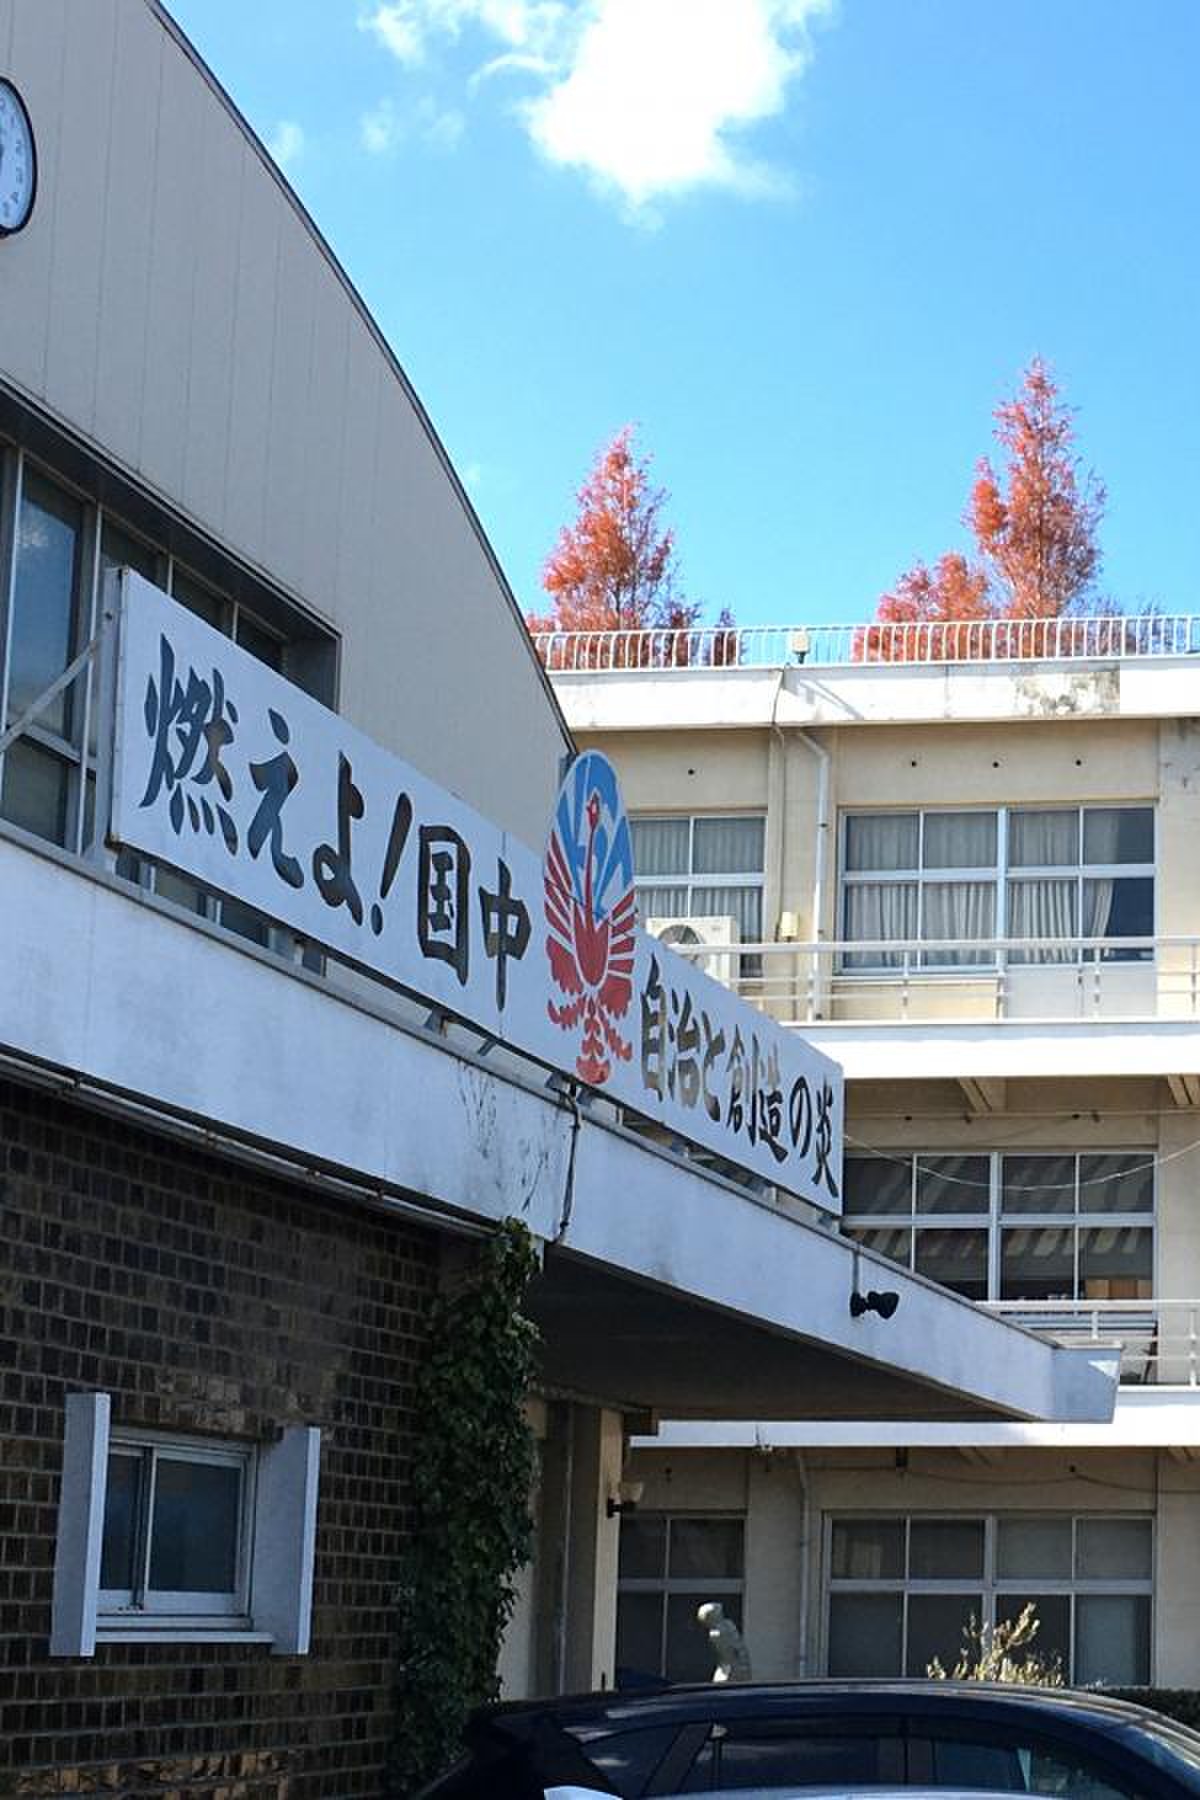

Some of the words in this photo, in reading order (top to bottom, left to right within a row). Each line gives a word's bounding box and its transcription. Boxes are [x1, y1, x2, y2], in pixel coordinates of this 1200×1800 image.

[640, 953, 838, 1198] 自治と創造の炎
